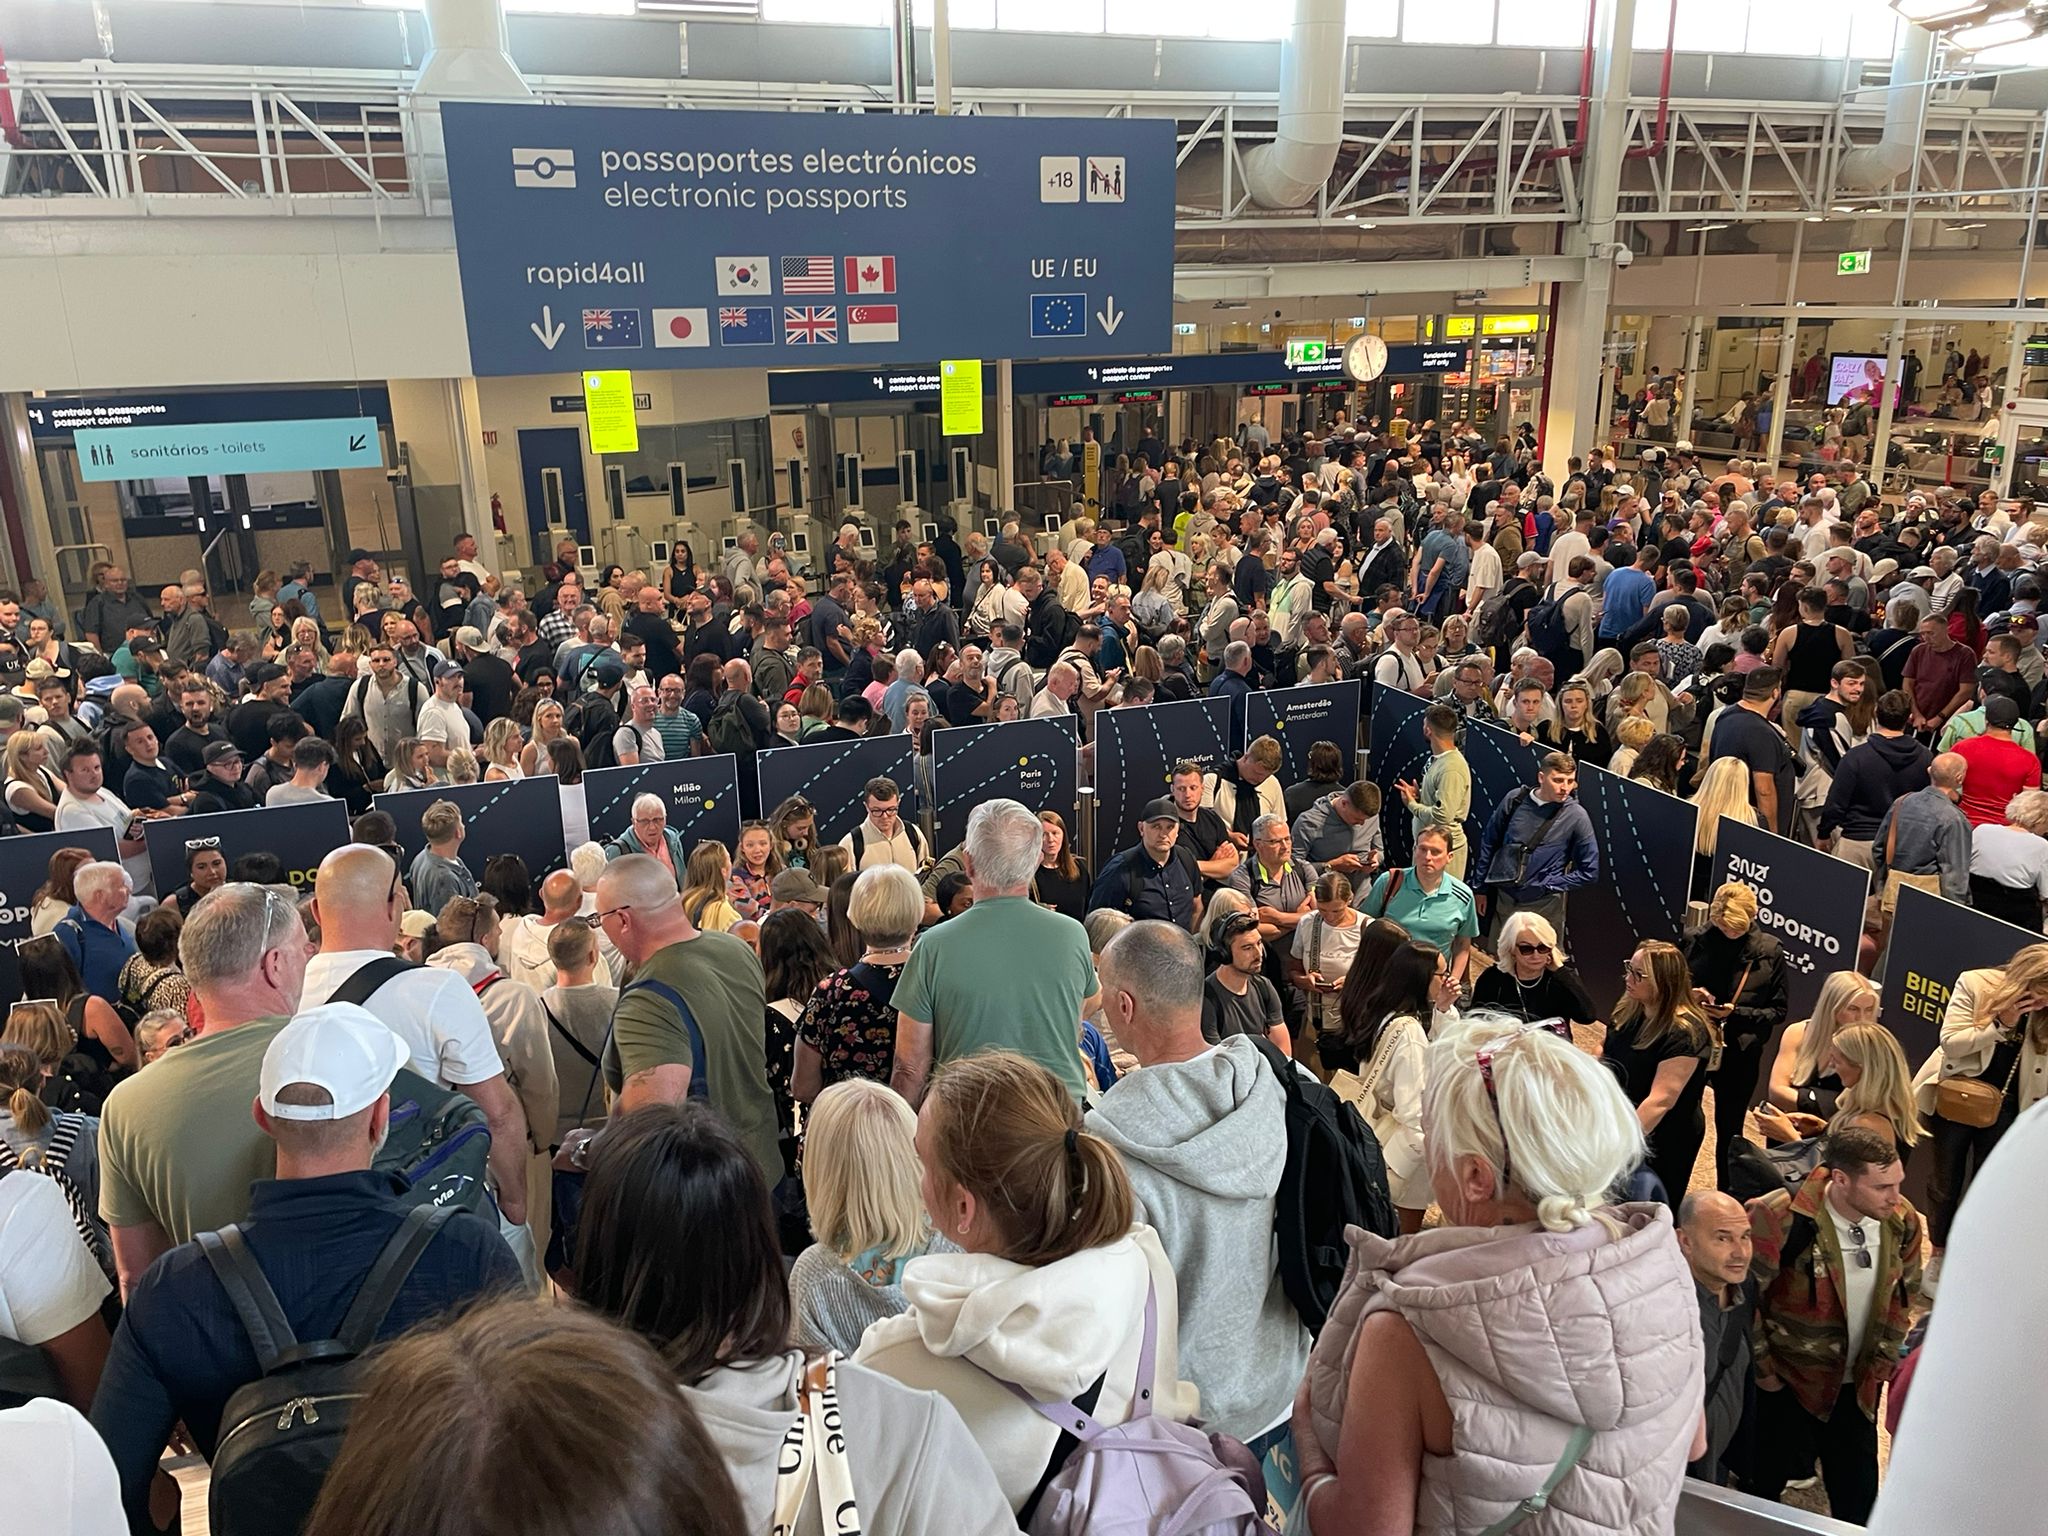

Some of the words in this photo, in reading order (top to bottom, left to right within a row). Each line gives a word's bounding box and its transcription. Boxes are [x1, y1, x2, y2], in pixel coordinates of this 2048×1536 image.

[601, 148, 793, 178] passaportes
[803, 147, 977, 175] electrónicos
[1048, 172, 1073, 188] +18
[604, 181, 756, 208] electronic
[766, 185, 907, 214] passports
[1031, 259, 1055, 278] UE
[1074, 258, 1097, 277] EU
[527, 261, 645, 289] rapid4all
[1102, 375, 1128, 383] passport
[889, 384, 918, 393] passport
[52, 407, 92, 417] controlo
[94, 406, 106, 415] de
[108, 405, 166, 416] passaportes
[54, 416, 96, 428] passport
[98, 415, 132, 425] control
[131, 444, 209, 459] sanitários
[221, 441, 266, 454] toilets
[1286, 699, 1332, 711] Amesterdão
[1286, 711, 1328, 721] Amsterdam
[1021, 769, 1041, 779] Paris
[673, 783, 701, 793] Milão
[1021, 780, 1040, 789] Paris
[674, 796, 701, 805] Milan
